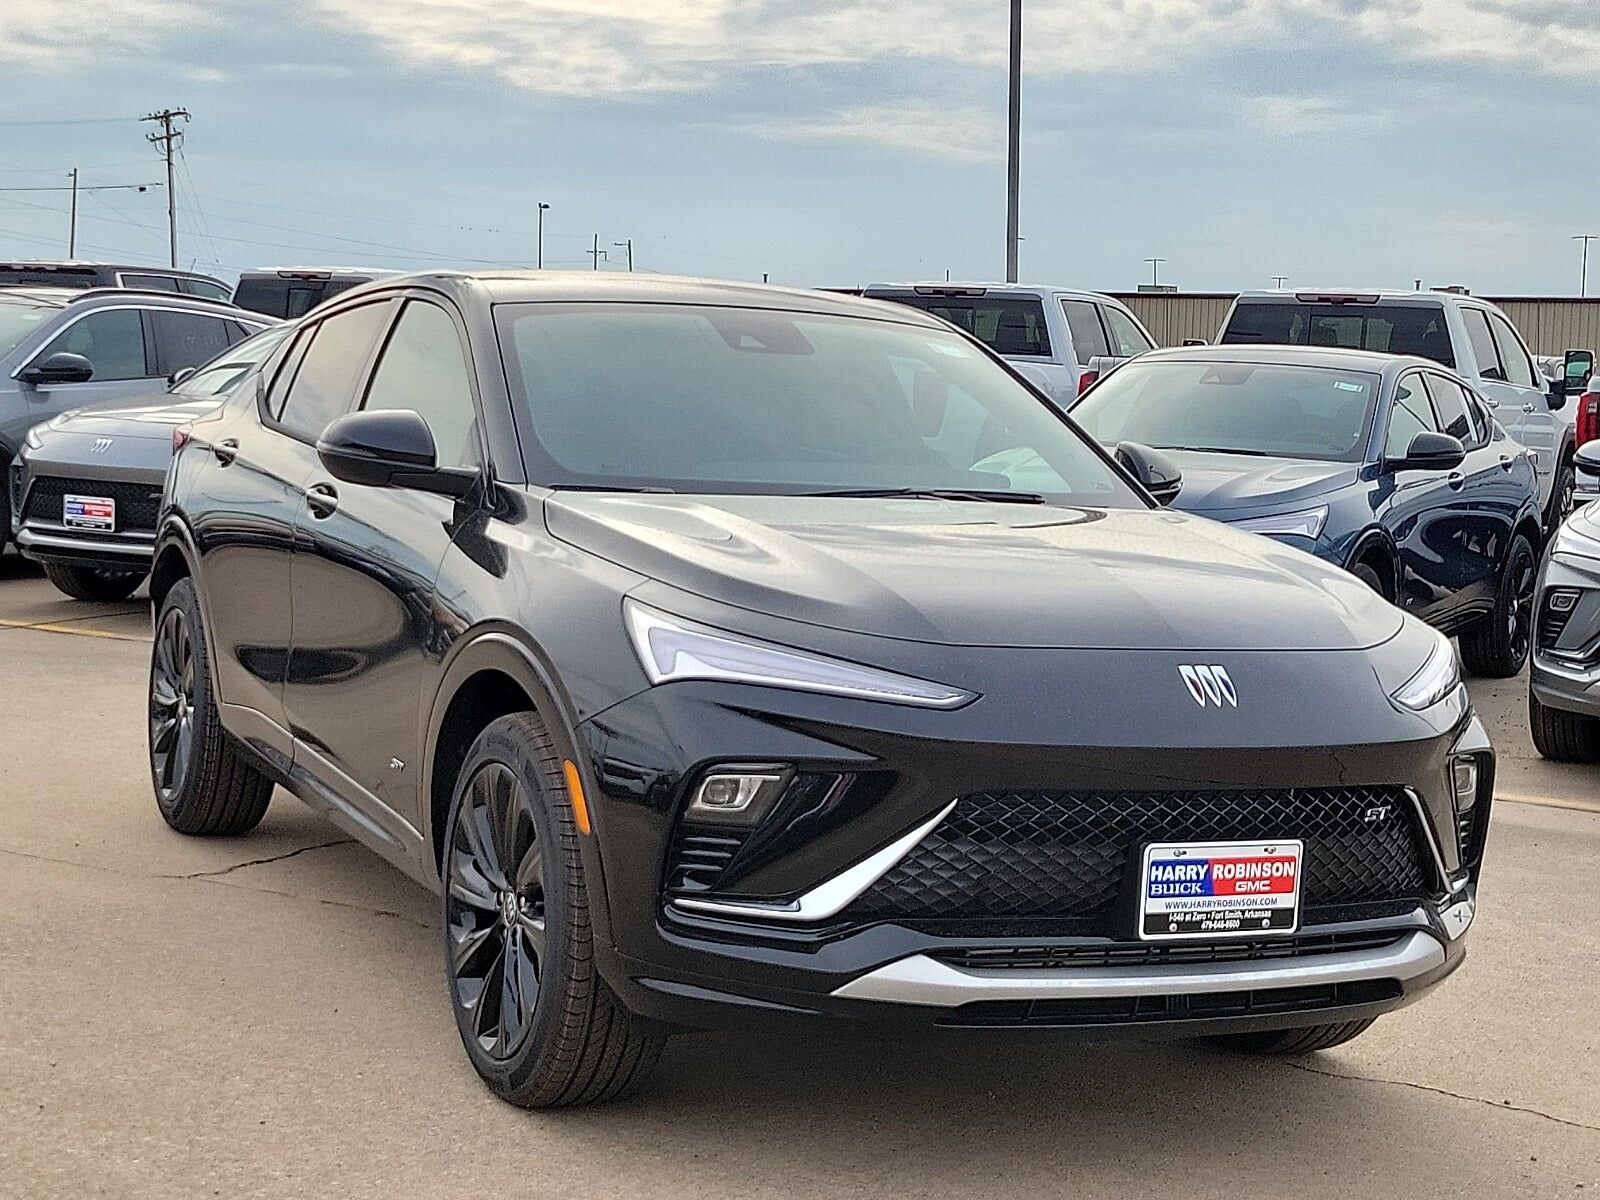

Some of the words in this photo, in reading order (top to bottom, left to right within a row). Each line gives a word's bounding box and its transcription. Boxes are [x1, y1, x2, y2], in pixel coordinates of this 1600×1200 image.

[1365, 805, 1391, 822] ST
[1150, 864, 1208, 881] HARRY
[1212, 861, 1295, 880] ROBINSON
[1150, 882, 1202, 895] BUICK
[1235, 880, 1271, 893] GMC
[1165, 897, 1278, 910] WWW.HARRYROBINSON.COM
[1211, 910, 1224, 920] Fort
[1244, 909, 1272, 919] Arkansas
